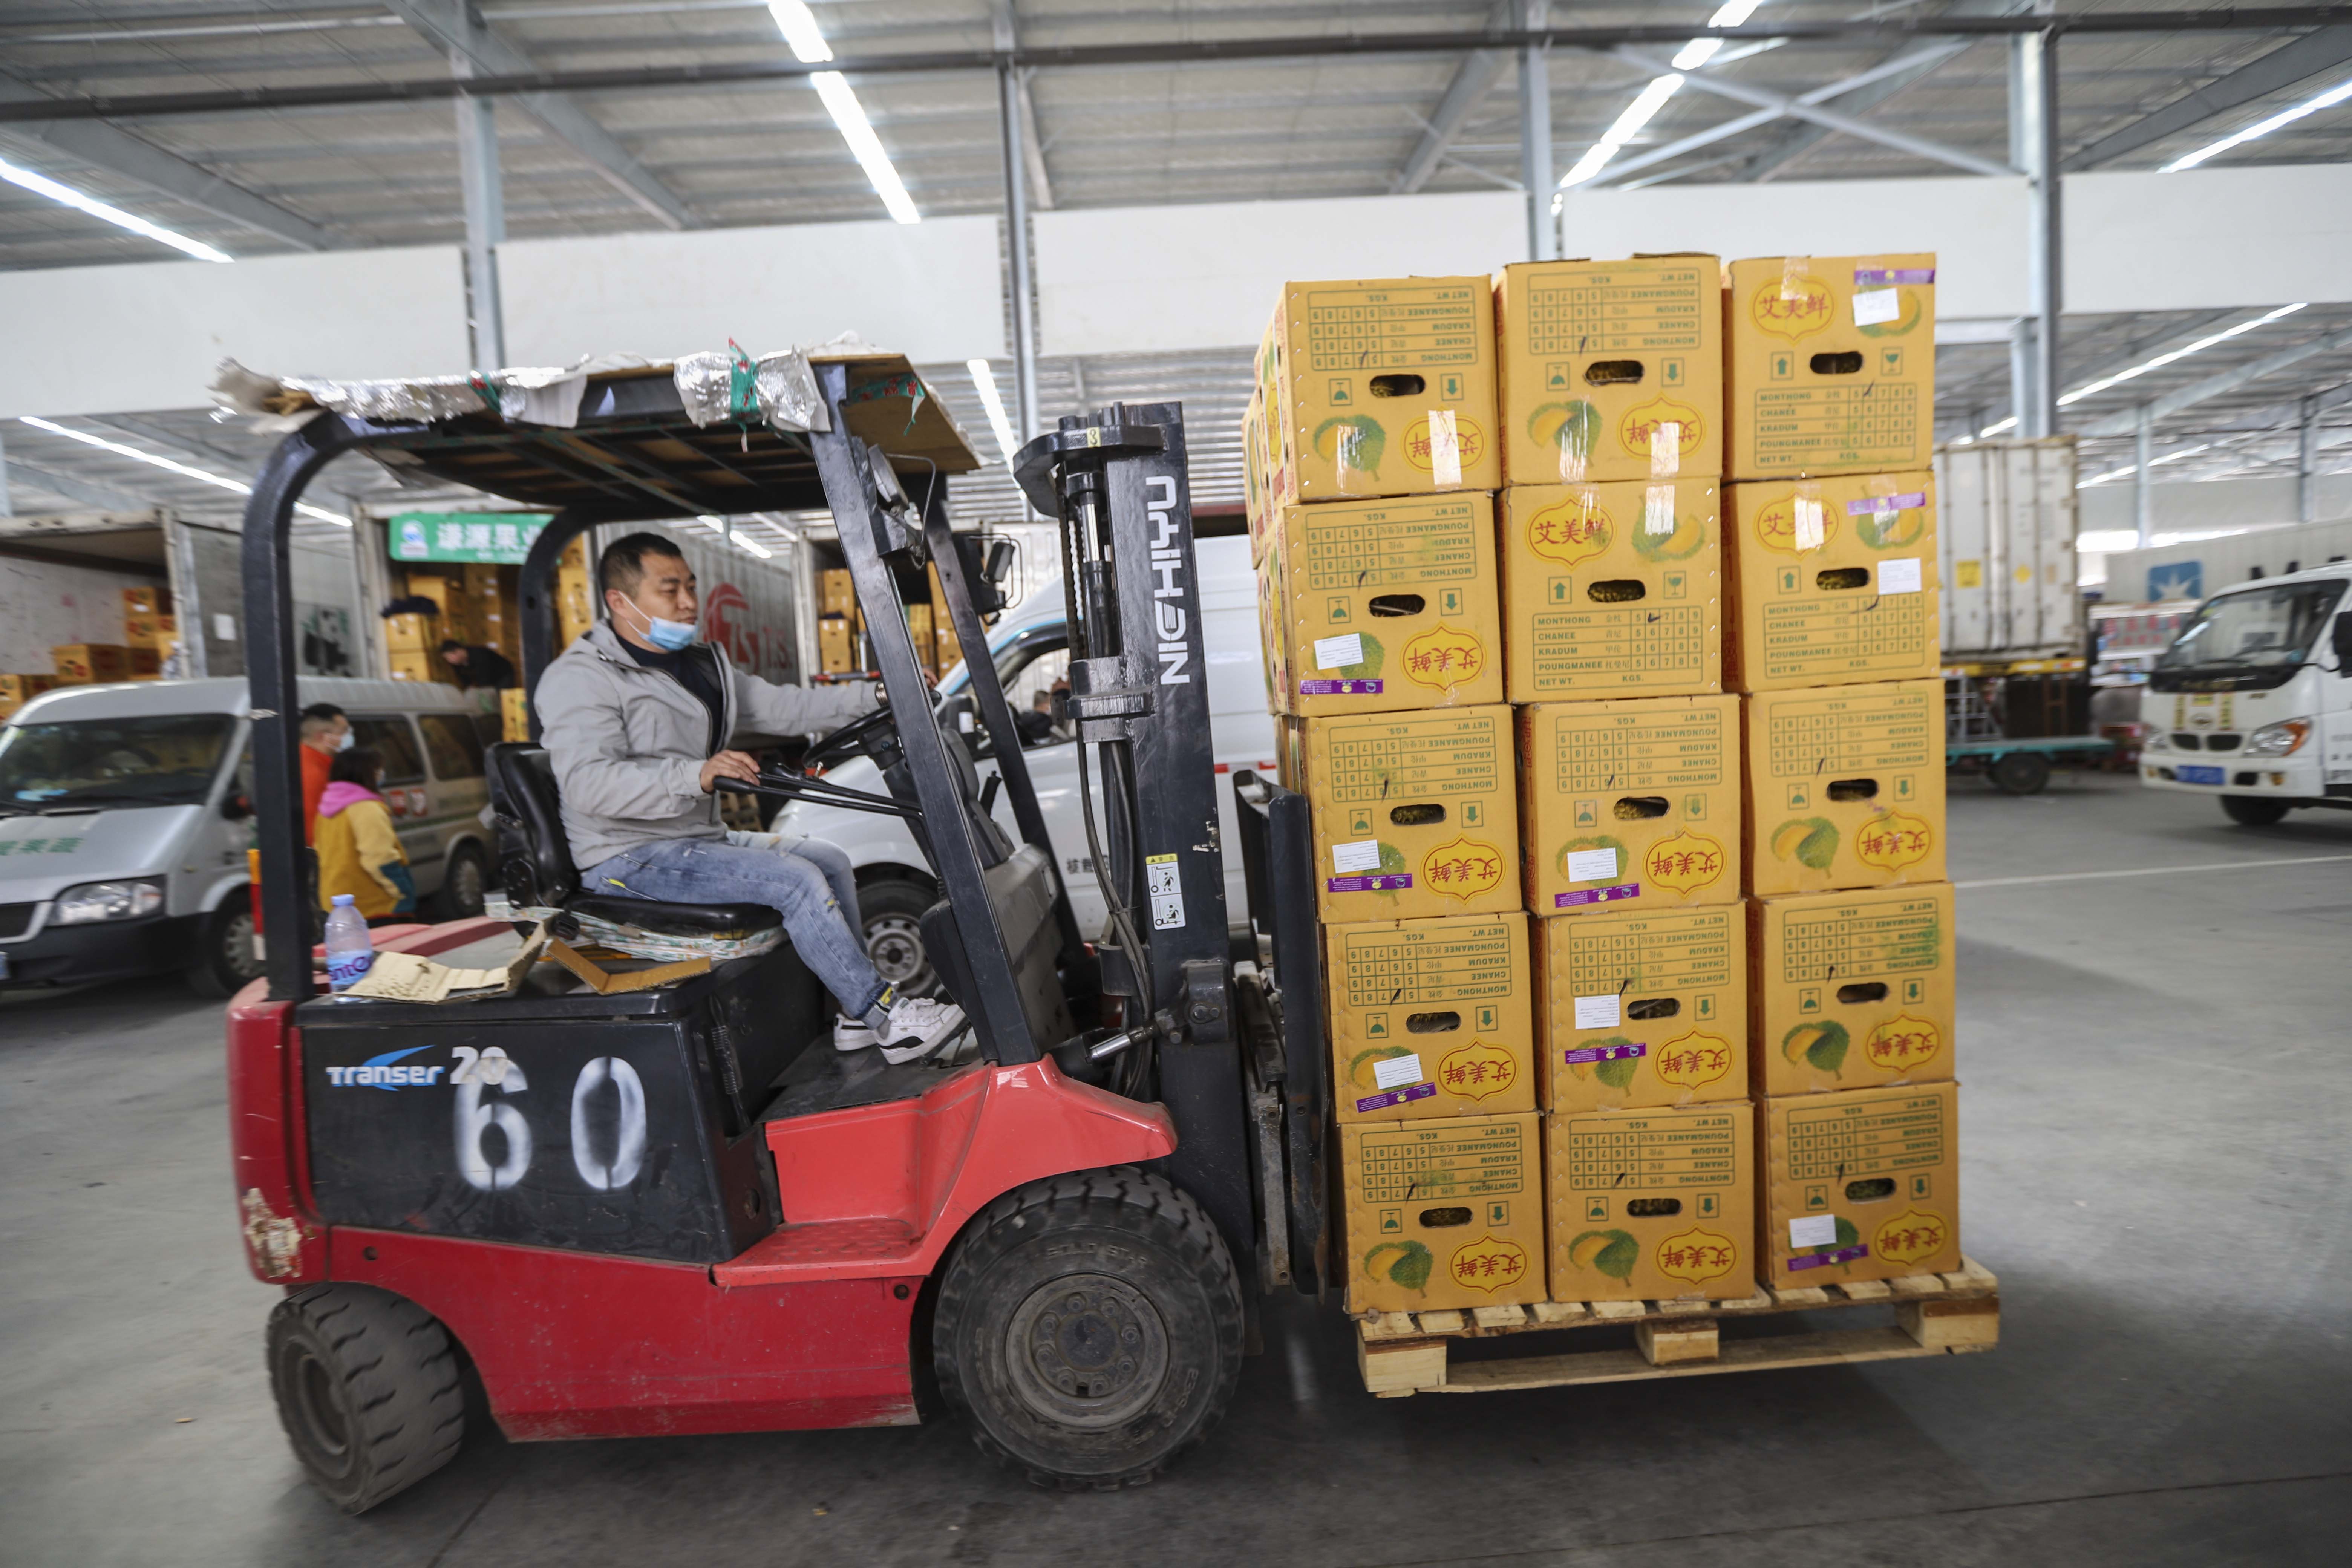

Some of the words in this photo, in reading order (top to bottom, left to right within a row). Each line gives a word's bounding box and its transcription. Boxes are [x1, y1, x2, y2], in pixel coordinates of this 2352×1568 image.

[1587, 276, 1611, 284] KGS.
[1631, 289, 1694, 299] POUNGMANEE
[1408, 306, 1469, 316] POUNGMANEE
[1656, 305, 1695, 313] KRADUM
[1433, 322, 1470, 330] KRADUM
[1658, 320, 1695, 329] CHANEE
[1435, 337, 1471, 346] CHANEE
[1643, 336, 1695, 345] MONTHONG
[1421, 352, 1472, 361] MONTHONG
[1406, 431, 1478, 458] 艾鲜
[1431, 507, 1448, 516] WT.
[1450, 506, 1467, 514] NET
[1363, 512, 1386, 521] KGS.
[1406, 521, 1468, 533] POUNGMANEE
[1534, 518, 1609, 546] 艾美鲜
[1420, 567, 1472, 577] MONTHONG
[1145, 475, 1190, 685] NICHIYU
[1538, 616, 1590, 625] MONTHONG
[1538, 632, 1575, 640] CHANEE
[1538, 647, 1577, 655] KRADUM
[1406, 646, 1480, 674] 艾美鲜
[1539, 661, 1602, 671] POUNGMANEE
[1559, 677, 1576, 685] WT.
[1613, 717, 1636, 725] KGS.
[1386, 726, 1409, 735] KGS.
[1453, 722, 1470, 730] WT.
[1655, 728, 1716, 738] POUNGMANEE
[1429, 736, 1490, 747] POUNGMANEE
[1679, 743, 1717, 752] KRADUM
[1453, 750, 1491, 760] KRADUM
[1681, 758, 1717, 767] CHANEE
[1456, 765, 1491, 775] CHANEE
[1667, 773, 1717, 782] MONTHONG
[1441, 780, 1492, 790] MONTHONG
[1860, 828, 1927, 856] 艾美鲜
[1650, 850, 1720, 877] 艾美鲜
[1427, 857, 1499, 884] 艾美鲜
[1625, 922, 1647, 931] KGS.
[1469, 928, 1485, 937] WT.
[1666, 931, 1724, 942] POUNGMANEE
[1444, 942, 1505, 953] POUNGMANEE
[1689, 946, 1724, 955] KRADUM
[1468, 957, 1505, 965] KRADUM
[1691, 960, 1724, 969] CHANEE
[1471, 971, 1506, 980] CHANEE
[1677, 974, 1725, 985] MONTHONG
[1457, 985, 1507, 995] MONTHONG
[1870, 1031, 1936, 1059] 艾美鲜
[1660, 1048, 1728, 1076] 艾美鲜
[1442, 1060, 1512, 1087] 艾美鲜
[454, 1056, 647, 1191] 60
[1667, 1132, 1729, 1141] POUNGMANEE
[1457, 1141, 1516, 1152] POUNGMANEE
[1481, 1155, 1517, 1163] KRADUM
[1483, 1168, 1517, 1177] CHANEE
[1678, 1174, 1729, 1183] MONTHONG
[1469, 1182, 1518, 1192] MONTHONG
[1878, 1225, 1944, 1254] 艾美鲜
[1661, 1246, 1733, 1271] 艾美鲜
[1454, 1253, 1523, 1279] 艾美鲜
